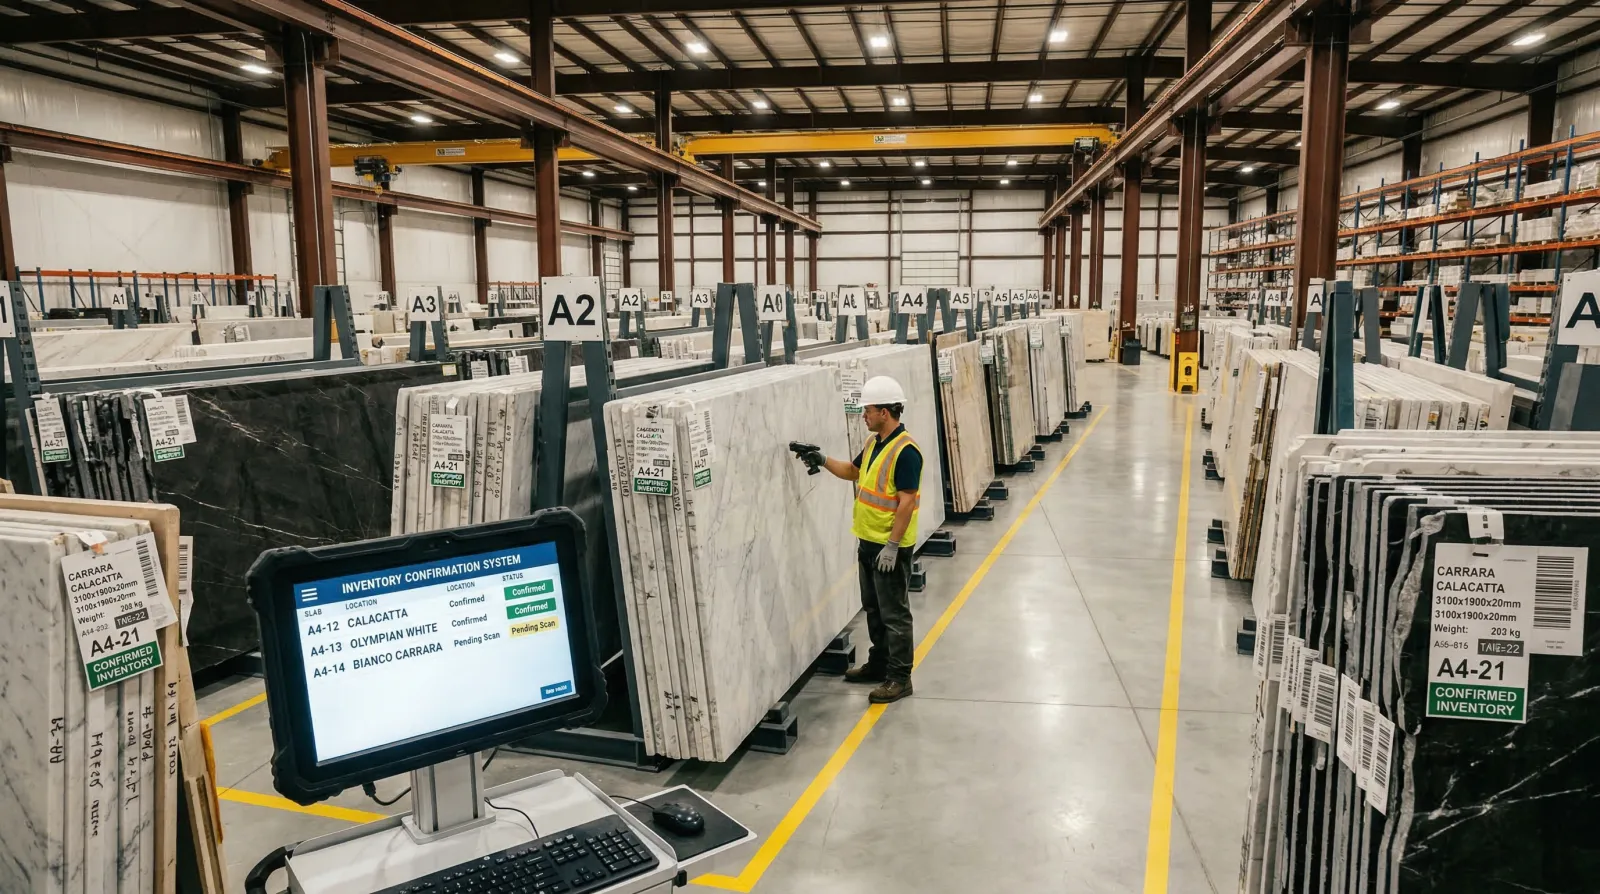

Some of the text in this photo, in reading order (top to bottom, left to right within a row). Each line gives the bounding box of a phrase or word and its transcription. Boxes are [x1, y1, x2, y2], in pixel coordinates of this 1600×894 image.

[112, 293, 125, 305] A1
[621, 294, 639, 306] A2
[694, 294, 708, 304] A3
[901, 293, 924, 307] A4
[952, 293, 970, 304] A5
[994, 293, 1008, 302] A5
[1012, 292, 1025, 301] A5
[412, 296, 437, 313] A3
[547, 294, 596, 326] A2
[44, 439, 64, 448] A4-21
[155, 436, 176, 447] A4-21
[434, 461, 458, 471] A4-21
[638, 466, 664, 478] A4-21
[68, 563, 113, 581] CARRARA
[342, 554, 521, 594] INVENTORY CONFIRMATION SYSTEM
[502, 572, 524, 582] STATUS
[1437, 566, 1495, 578] CARRARA
[71, 572, 123, 593] CALACATTA
[447, 581, 475, 592] LOCATION
[1436, 581, 1505, 594] CALACATTA
[74, 580, 138, 604] 3100x1900x20mm
[512, 583, 546, 597] Confirmed
[345, 598, 378, 610] LOCATION
[449, 594, 485, 608] Confirmed
[514, 601, 549, 615] Confirmed
[1435, 596, 1521, 609] 3100x1900x20mm
[78, 612, 105, 625] Weight:
[134, 601, 144, 610] kg
[304, 608, 322, 618] SLAB
[1435, 610, 1517, 622] 3100x1900x20mm
[307, 608, 408, 636] A4-12 CALACATTA
[451, 614, 487, 627] Confirmed
[511, 619, 556, 636] Pending Scan
[1434, 624, 1521, 638] Weight: 203 kg
[90, 627, 140, 657] A4-21
[310, 622, 438, 657] A4-13 OLYMPIAN WHITE
[454, 632, 500, 648] Pending Scan
[93, 645, 153, 673] CONFIRMED
[313, 642, 443, 679] A4-14 BIANCO CARRARA
[97, 656, 154, 683] INVENTORY
[1437, 658, 1504, 681] A4-21
[1435, 687, 1517, 702] CONFIRMED
[1436, 701, 1515, 716] INVENTORY
